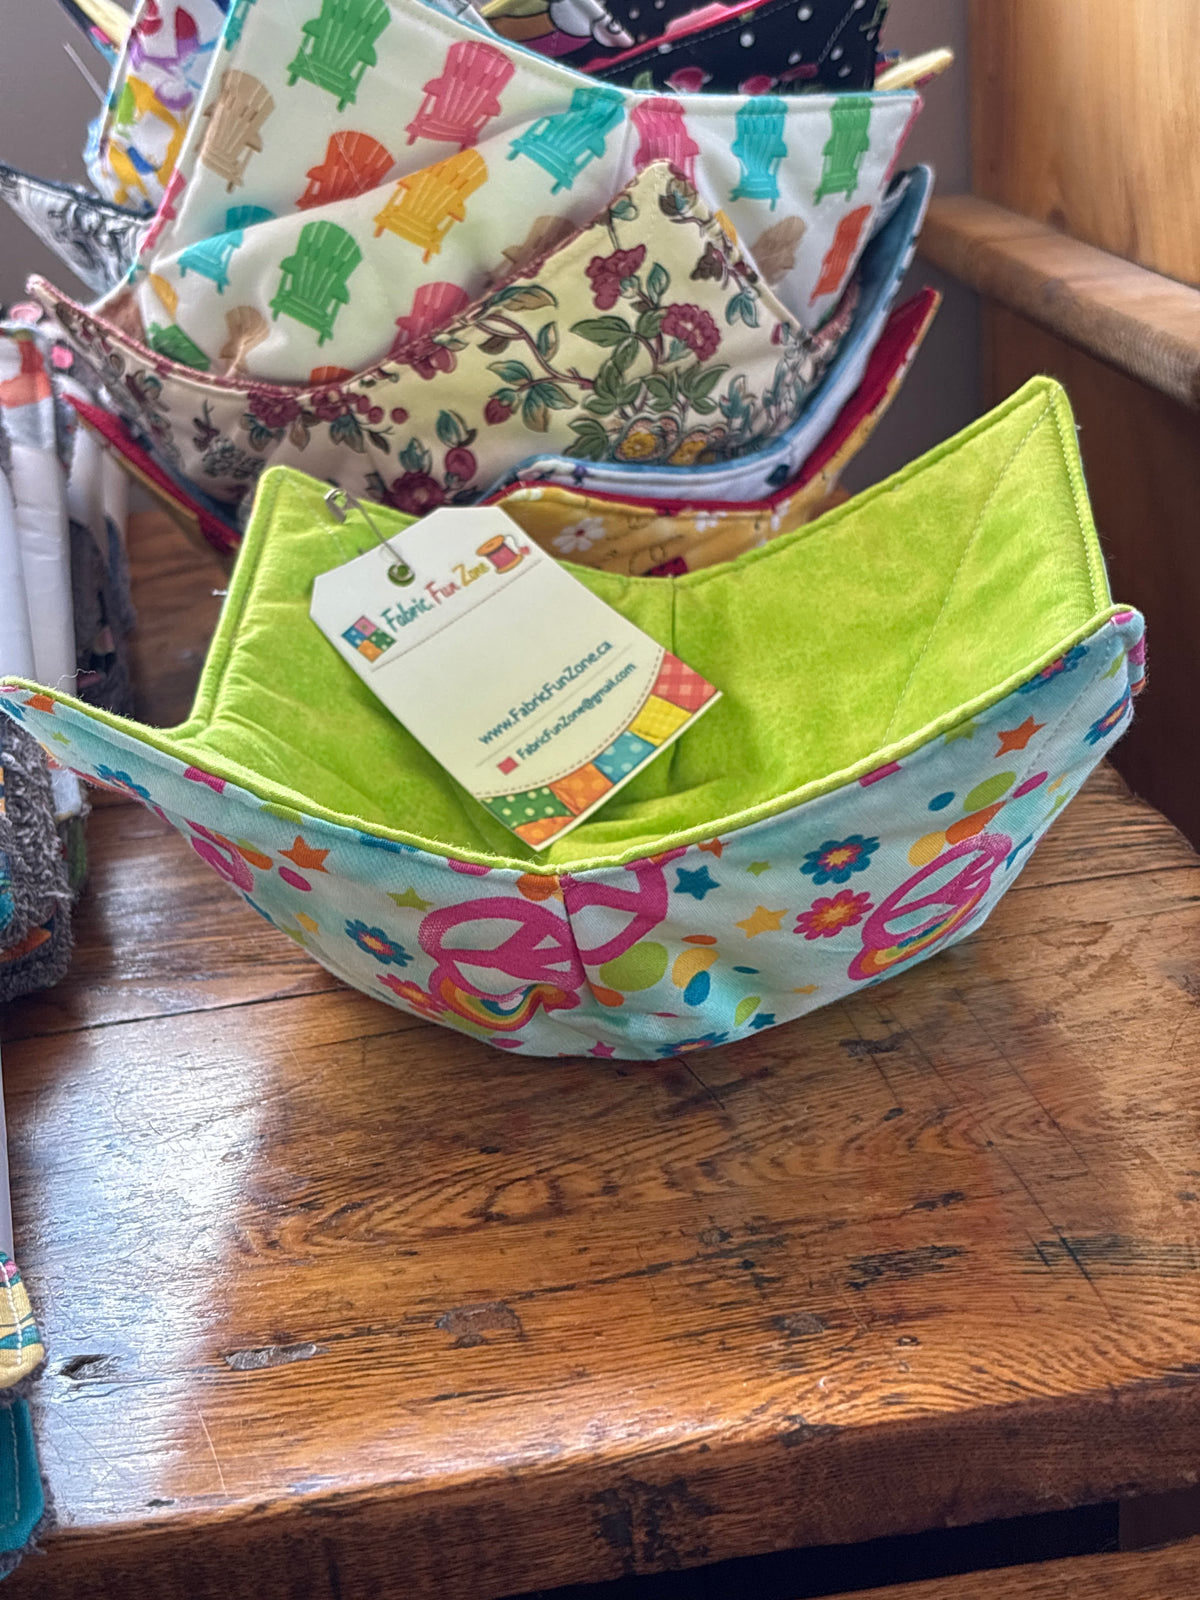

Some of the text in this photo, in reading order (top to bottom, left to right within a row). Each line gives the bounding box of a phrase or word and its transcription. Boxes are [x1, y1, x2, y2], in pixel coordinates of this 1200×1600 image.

[425, 581, 461, 604] Fun
[452, 562, 490, 586] Zone
[478, 641, 613, 744] www.FabricFunZone.ca
[516, 663, 636, 760] FabricFunZone@gmail.com
